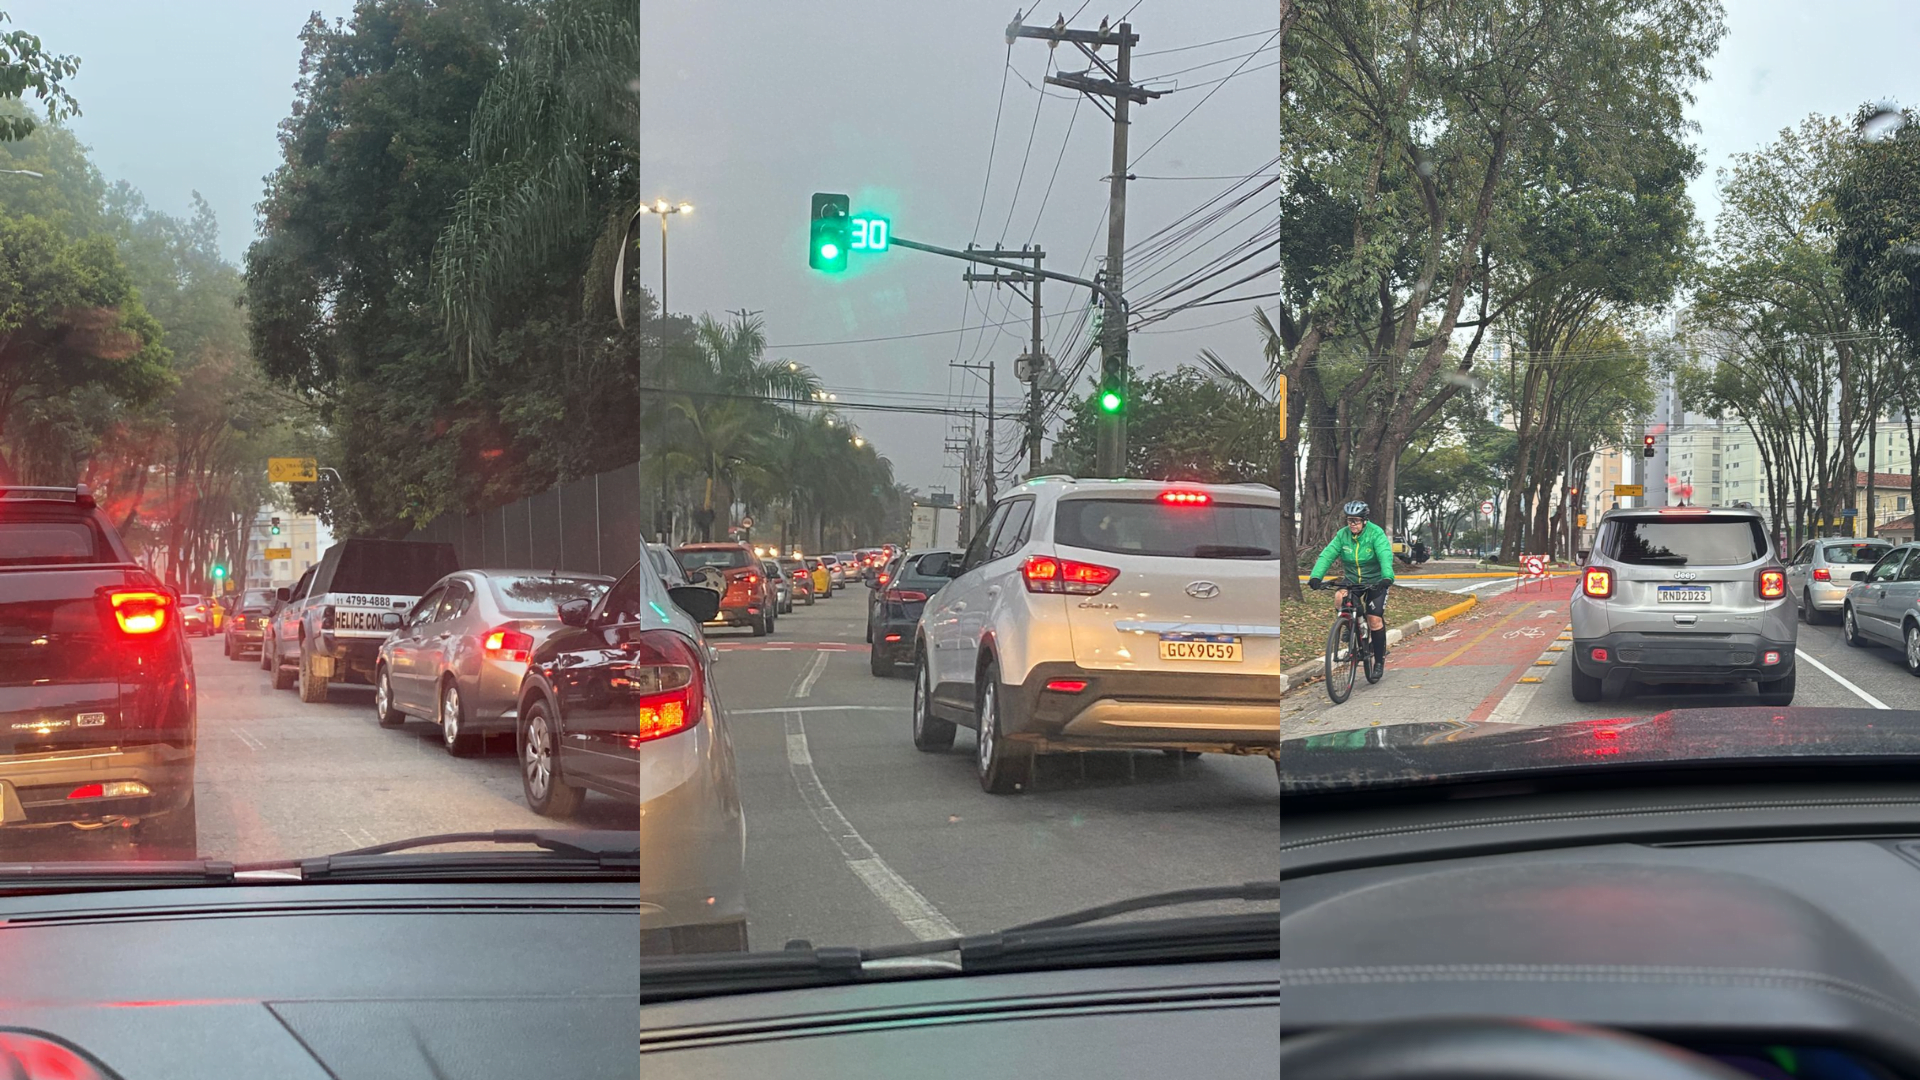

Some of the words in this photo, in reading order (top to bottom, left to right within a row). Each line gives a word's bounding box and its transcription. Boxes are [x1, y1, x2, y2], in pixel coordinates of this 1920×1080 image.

[851, 218, 887, 249] 30
[1674, 571, 1696, 580] Jeep
[336, 597, 344, 605] 11
[345, 595, 391, 607] 4799-4888
[1662, 591, 1706, 601] RND2D23
[335, 611, 364, 629] HELICE
[1167, 642, 1234, 659] GCX9C59
